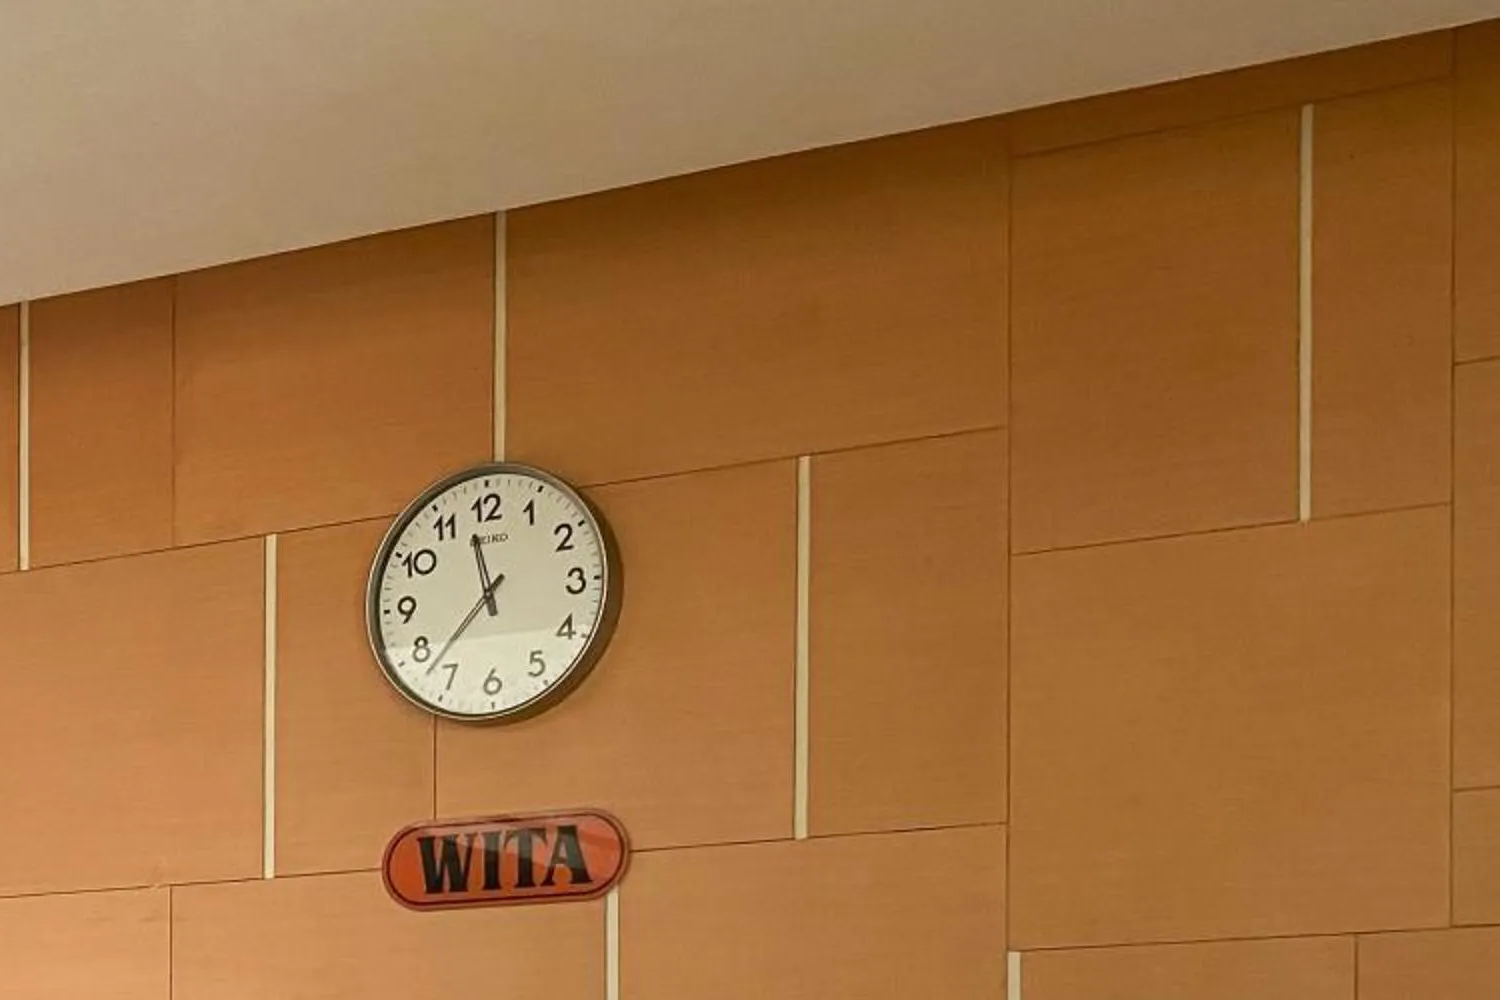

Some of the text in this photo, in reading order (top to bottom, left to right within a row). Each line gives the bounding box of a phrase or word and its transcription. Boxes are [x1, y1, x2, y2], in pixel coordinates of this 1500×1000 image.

[470, 493, 502, 523] 12
[523, 499, 535, 526] 1
[432, 513, 457, 541] 11
[553, 523, 574, 552] 2
[401, 549, 437, 578] 10
[564, 567, 587, 594] 3
[397, 596, 417, 624] 9
[556, 613, 577, 640] 4
[412, 636, 431, 663] 8
[528, 650, 546, 677] 5
[442, 663, 459, 691] 7
[483, 668, 502, 695] 6
[417, 825, 594, 894] WITA
